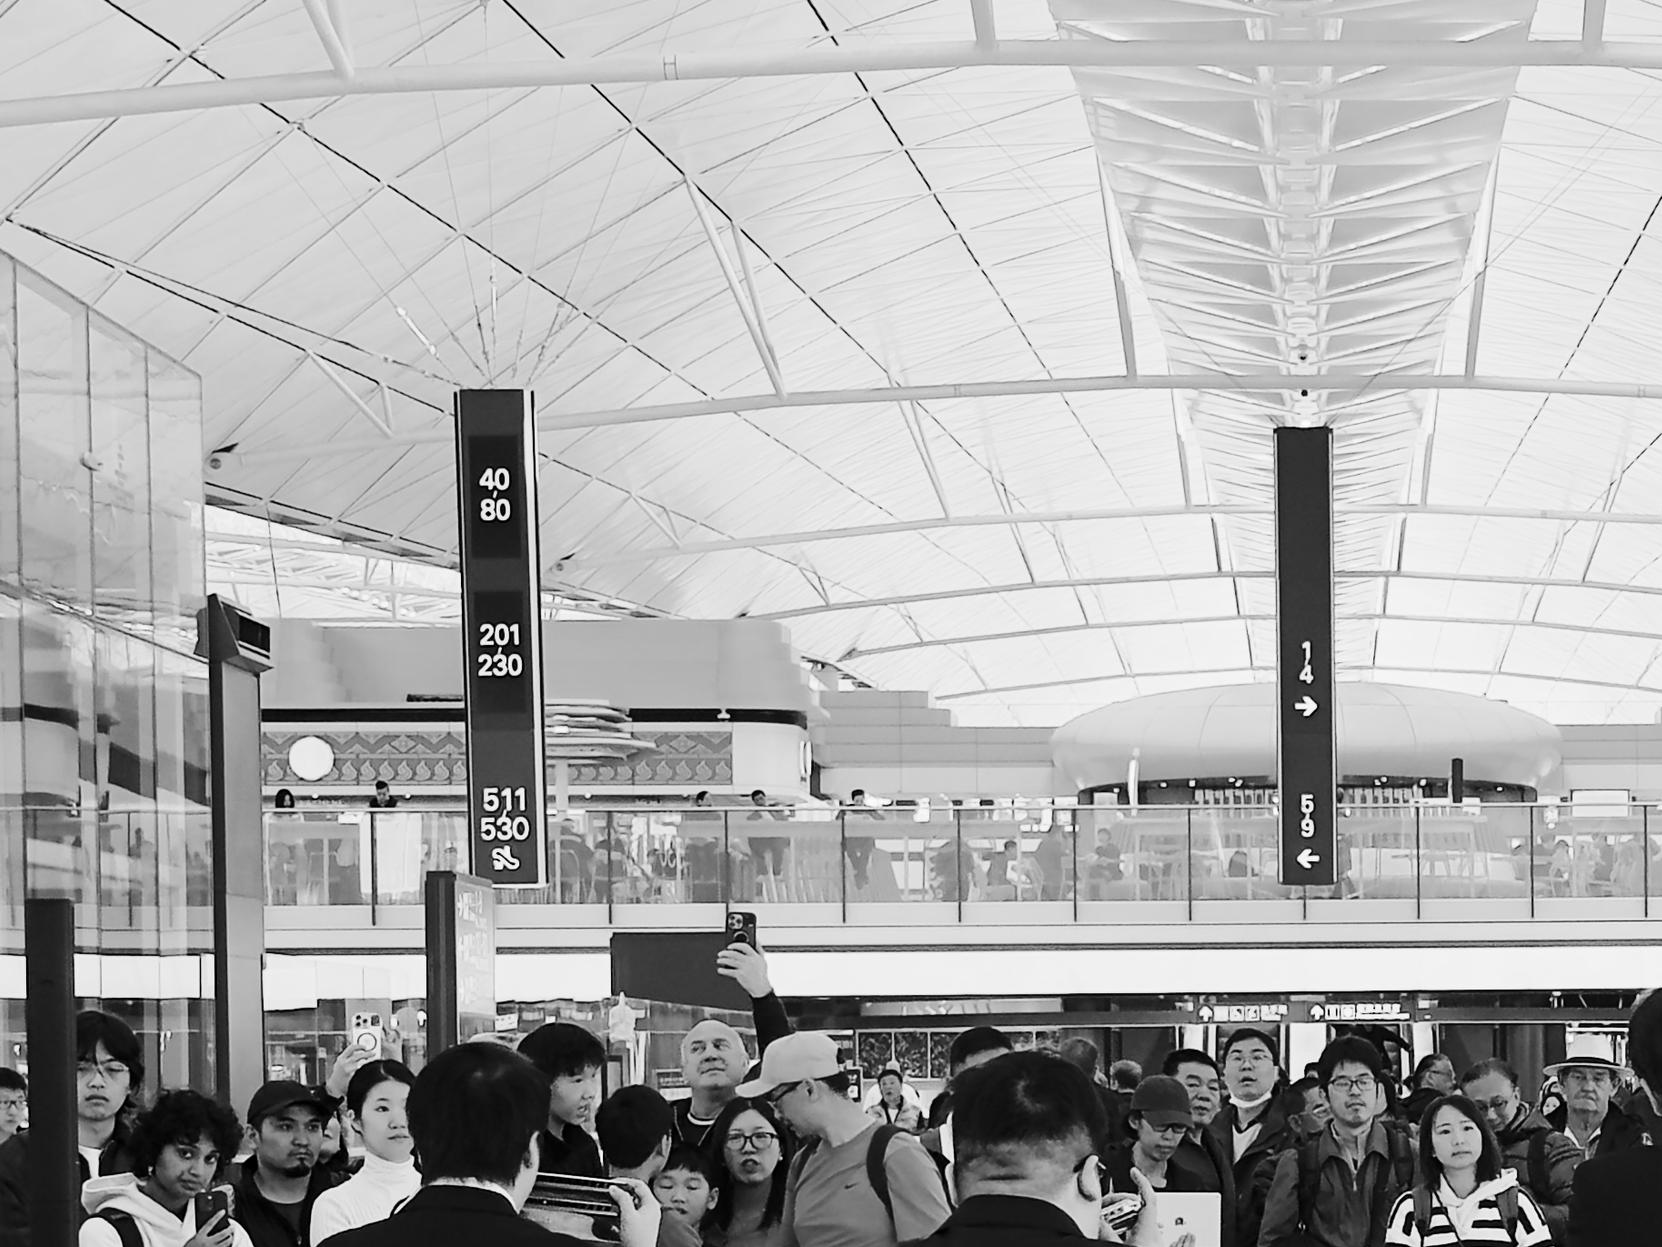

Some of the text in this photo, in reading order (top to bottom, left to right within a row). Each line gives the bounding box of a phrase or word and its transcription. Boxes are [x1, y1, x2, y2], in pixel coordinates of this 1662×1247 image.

[480, 468, 510, 491] 40
[480, 498, 511, 521] 80
[479, 624, 520, 646] 201
[1301, 641, 1311, 662] 1
[478, 654, 523, 677] 230
[1299, 664, 1314, 684] 4
[483, 788, 527, 811] 511
[1300, 794, 1314, 813] 5
[480, 817, 530, 841] 530
[1300, 817, 1314, 838] 9
